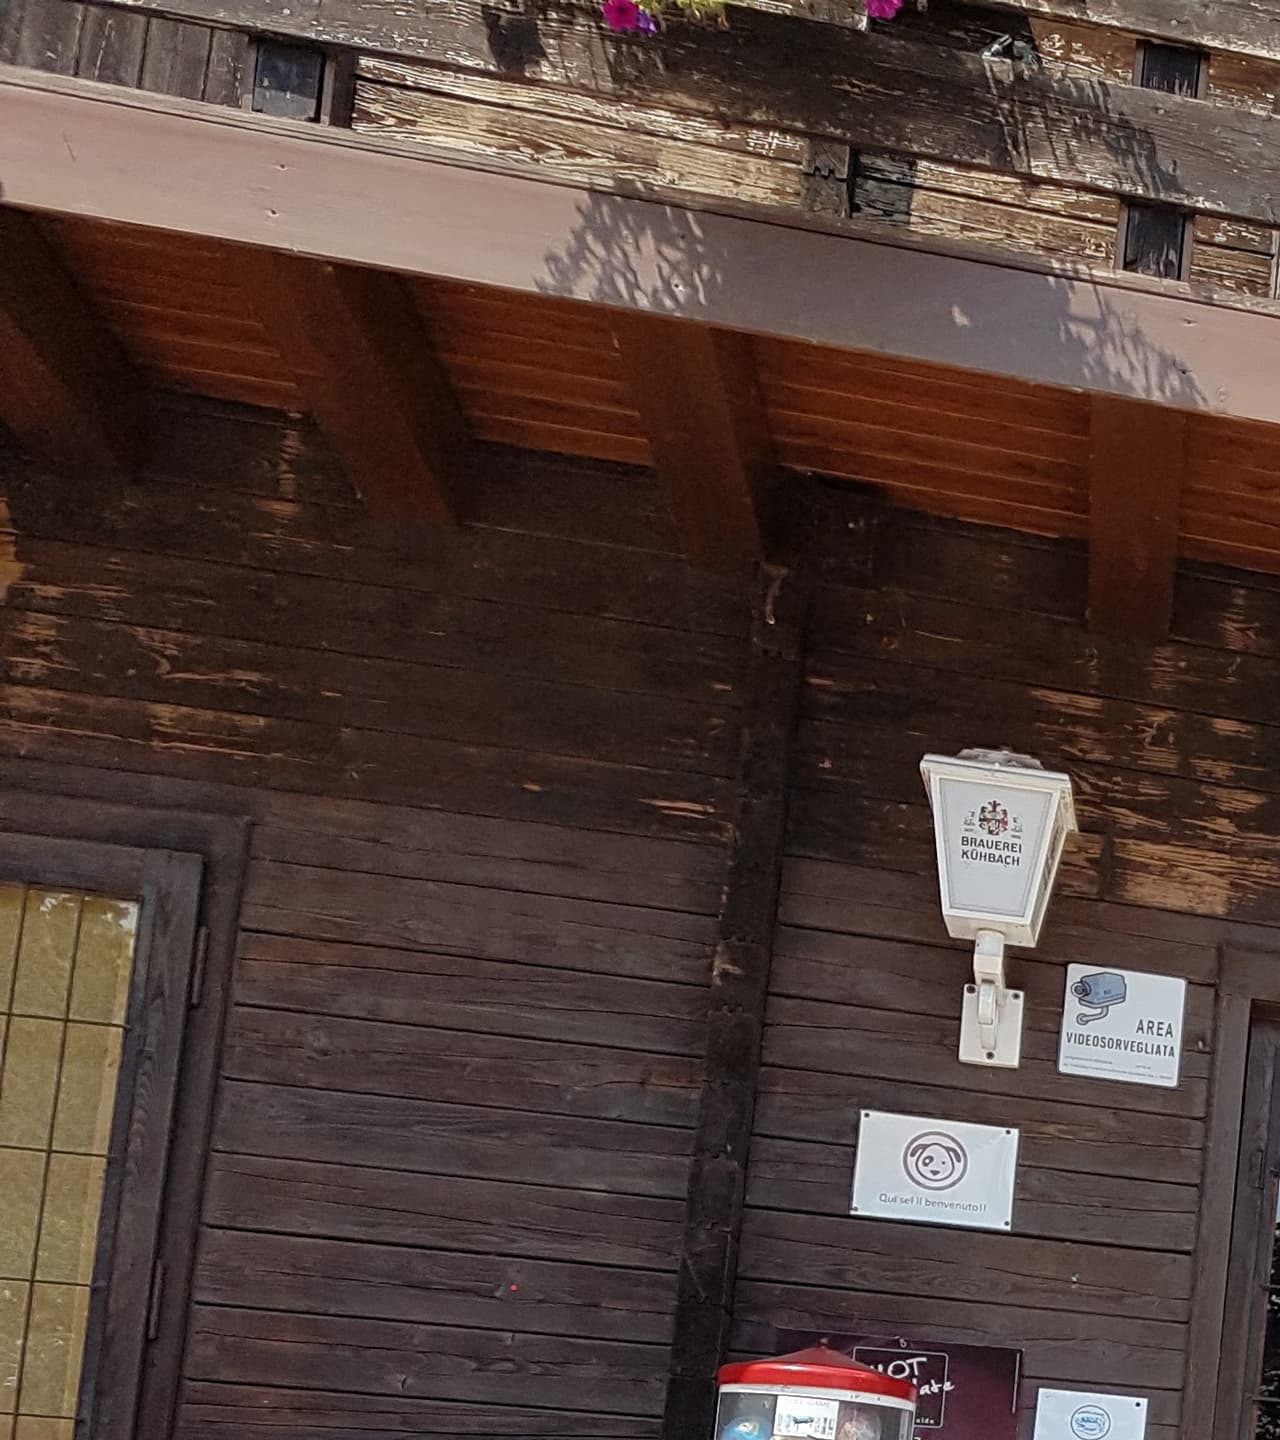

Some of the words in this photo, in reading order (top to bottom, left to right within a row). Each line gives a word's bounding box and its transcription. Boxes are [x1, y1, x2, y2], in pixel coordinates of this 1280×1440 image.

[961, 836, 1022, 853] BRAUEREI
[961, 849, 1020, 866] KÜHBACH
[1135, 1019, 1174, 1038] AREA
[1065, 1031, 1175, 1058] VIDEOSORVEGLIATA
[879, 1193, 897, 1203] Qui
[899, 1196, 913, 1205] sei
[916, 1197, 922, 1205] il
